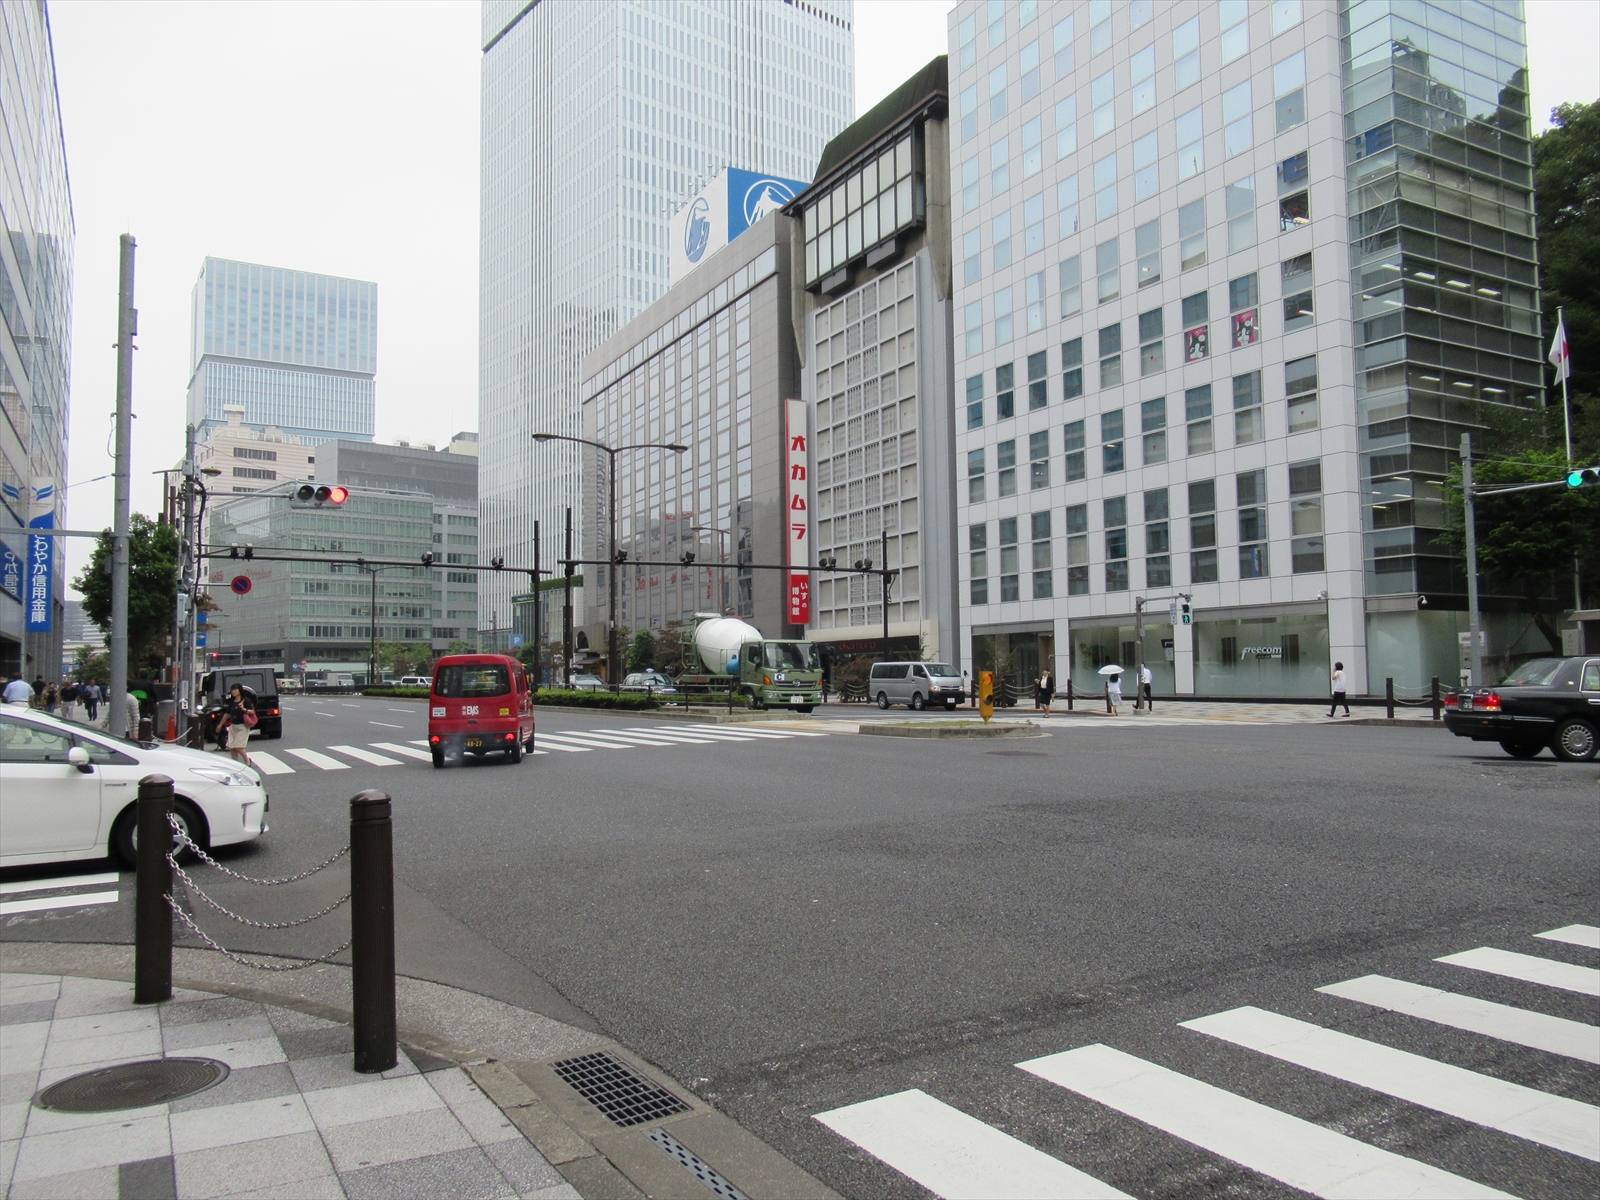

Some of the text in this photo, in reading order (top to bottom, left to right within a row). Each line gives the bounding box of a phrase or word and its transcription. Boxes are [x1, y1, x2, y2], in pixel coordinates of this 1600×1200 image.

[791, 436, 806, 540] オカムラ
[791, 587, 800, 616] 博物館
[800, 582, 808, 608] いすの
[514, 637, 521, 645] P
[839, 642, 877, 650] okamura
[1241, 646, 1282, 660] freecom
[466, 705, 479, 715] EMS
